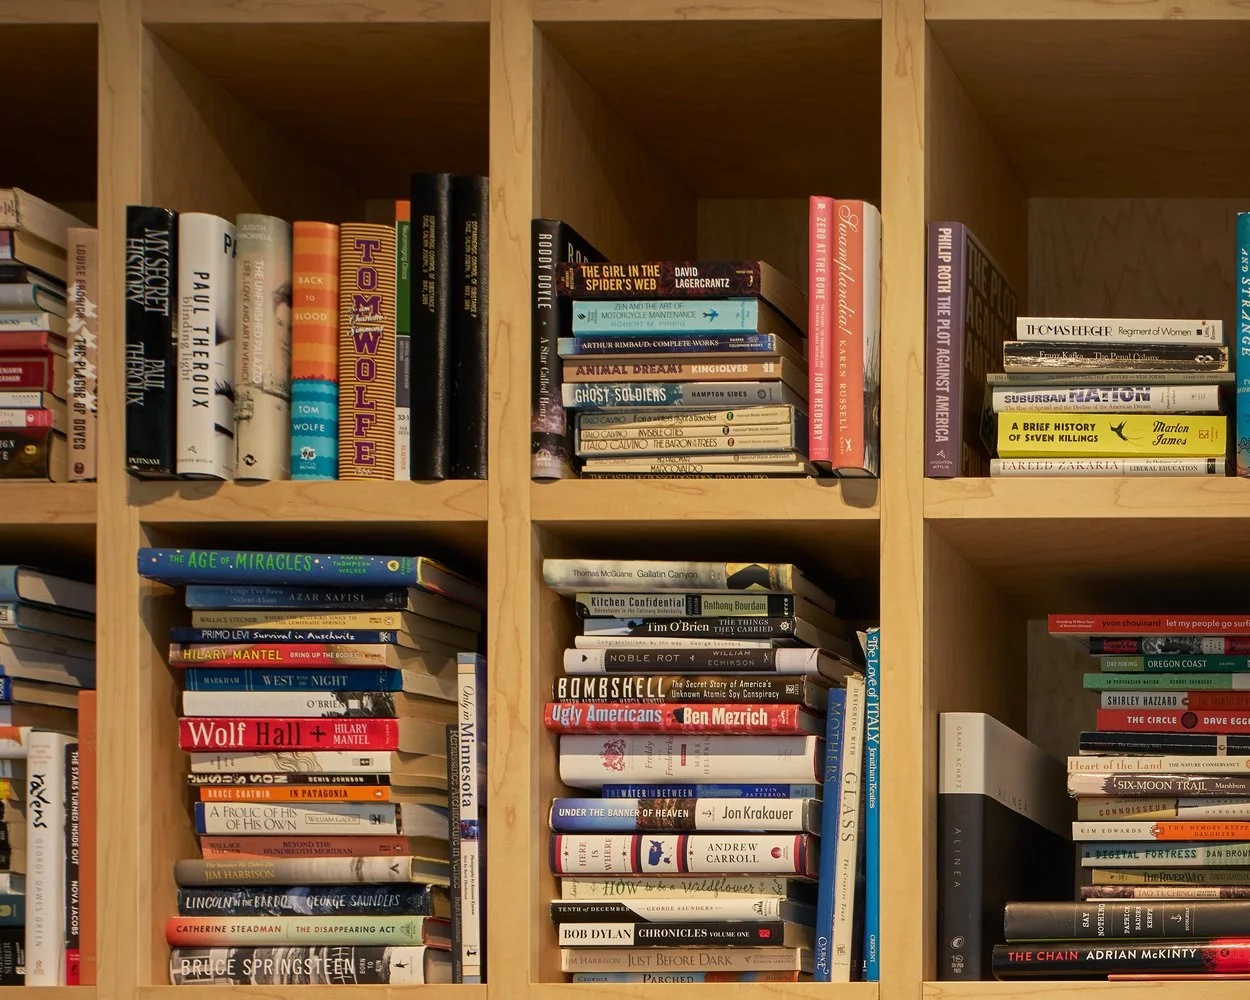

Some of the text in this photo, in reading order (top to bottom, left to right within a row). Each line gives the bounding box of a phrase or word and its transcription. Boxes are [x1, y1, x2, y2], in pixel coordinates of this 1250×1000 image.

[581, 264, 660, 277] THE GIRL IN THE
[674, 267, 698, 277] DAVID
[298, 275, 324, 285] BACK
[586, 278, 657, 291] SPIDER'S WEB
[675, 277, 730, 289] LAGERCRANTZ
[305, 294, 316, 302] TO
[296, 312, 327, 321] BLOOD
[1026, 324, 1112, 337] THOMAS BERGER
[1118, 326, 1192, 337] Regiment of Women
[353, 238, 381, 466] TOM WOLFE
[576, 363, 682, 375] ANIMAL DREAMS
[575, 388, 666, 403] GHOST SOLDIERS
[298, 406, 319, 414] TOM
[839, 382, 847, 431] RUSSELL
[293, 422, 325, 432] WOLFE
[1011, 423, 1096, 432] A BRIEF HISTORY
[1152, 421, 1189, 435] Marlon
[1008, 434, 1020, 442] OF
[1152, 433, 1187, 446] James
[169, 552, 312, 572] THE AGE OF MIRACLES
[591, 596, 685, 608] Kitchen Confidential
[703, 600, 766, 612] Anthony Bourdain
[183, 649, 283, 660] HILARY MANTEL
[558, 677, 666, 699] BOMBSHELL
[1107, 696, 1177, 706] SHIRLEY HAZZARD
[551, 705, 768, 726] Ugly Americans Ben Mezrich
[1147, 716, 1177, 724] CIRCLE
[1203, 717, 1228, 725] DAVE
[188, 722, 301, 746] Wolf Hall
[334, 723, 367, 734] HILARY
[333, 734, 370, 745] MANTEL
[1118, 780, 1207, 791] SIX-MOON TRAIL
[289, 789, 348, 798] IN PATAGONIA
[559, 808, 689, 818] UNDER THE BANNER OF HEAVEN
[722, 805, 793, 821] Jon Krakauer
[314, 925, 377, 933] DISAPPEARING
[563, 929, 708, 940] BOB DYLAN CHRONICLES
[1008, 948, 1197, 962] THE CHAIN ADRIAN McKINTY
[181, 958, 355, 976] BRUCE SPRINGSTEEN
